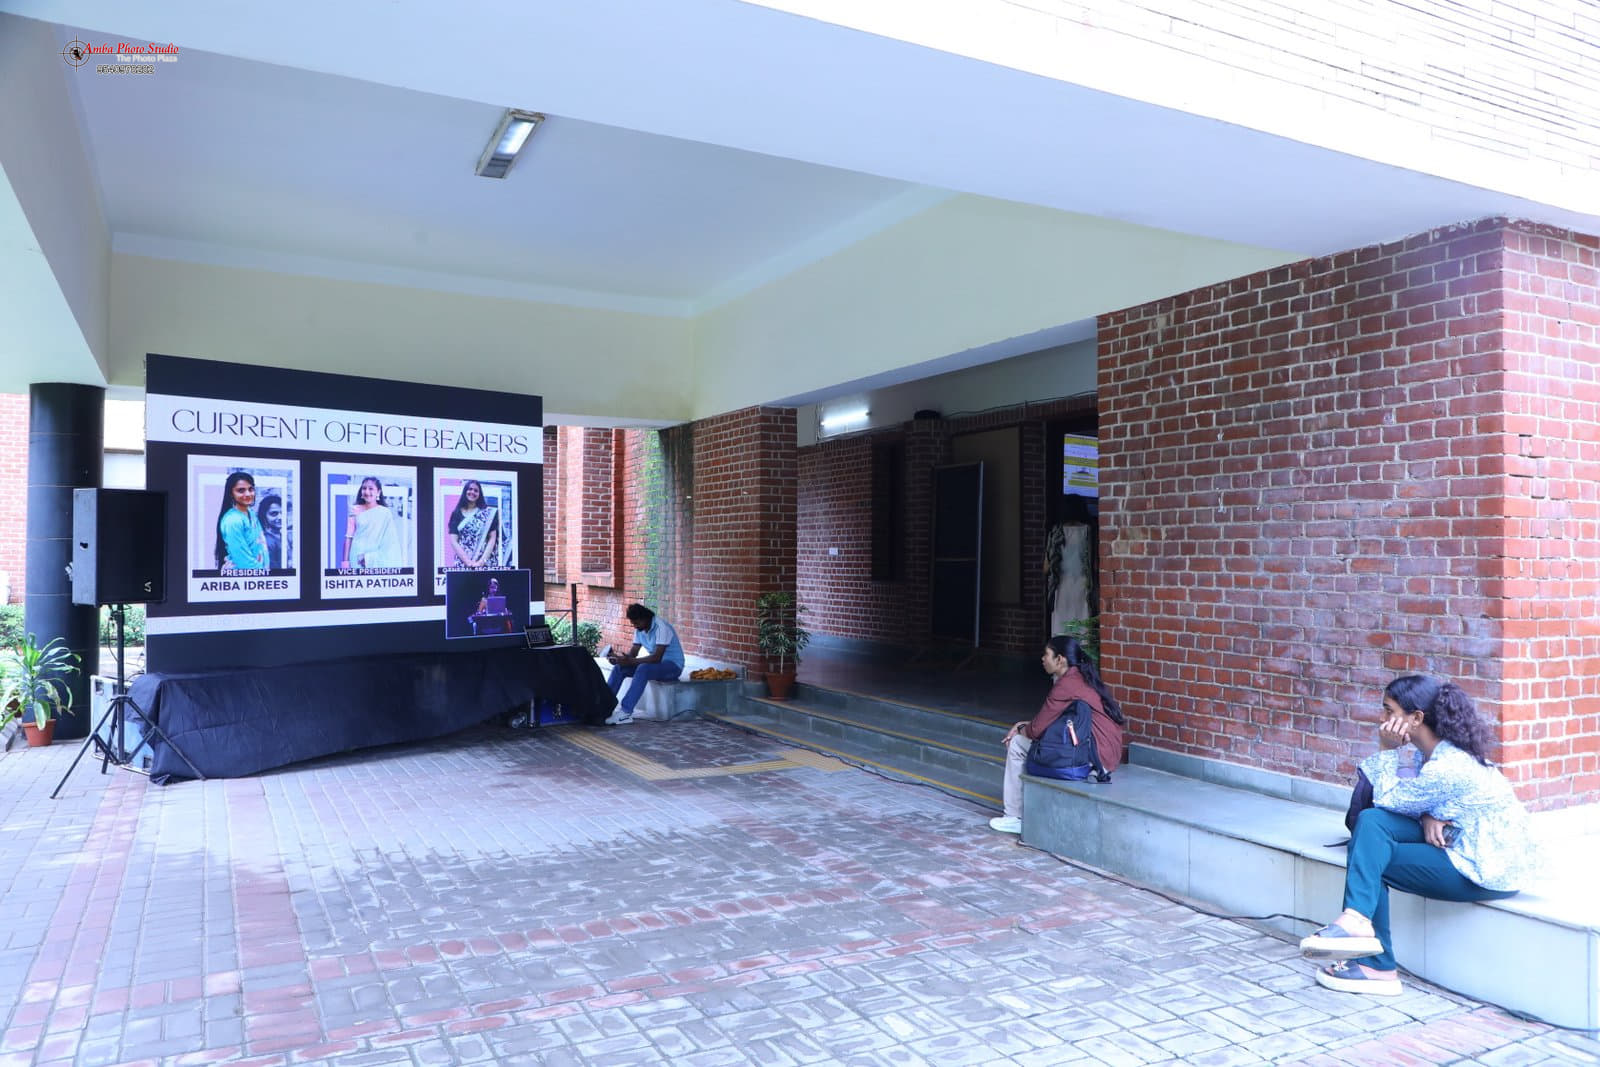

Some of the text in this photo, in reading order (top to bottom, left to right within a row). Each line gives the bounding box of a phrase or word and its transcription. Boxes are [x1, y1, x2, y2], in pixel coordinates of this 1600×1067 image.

[171, 408, 529, 456] CURRENT OFFICE BEARERS
[220, 569, 271, 577] PRESIDENT
[339, 568, 402, 576] VICE PRESIDENT
[200, 580, 289, 591] ARIBA IDREES
[325, 578, 414, 589] ISHITA PATIDAR
